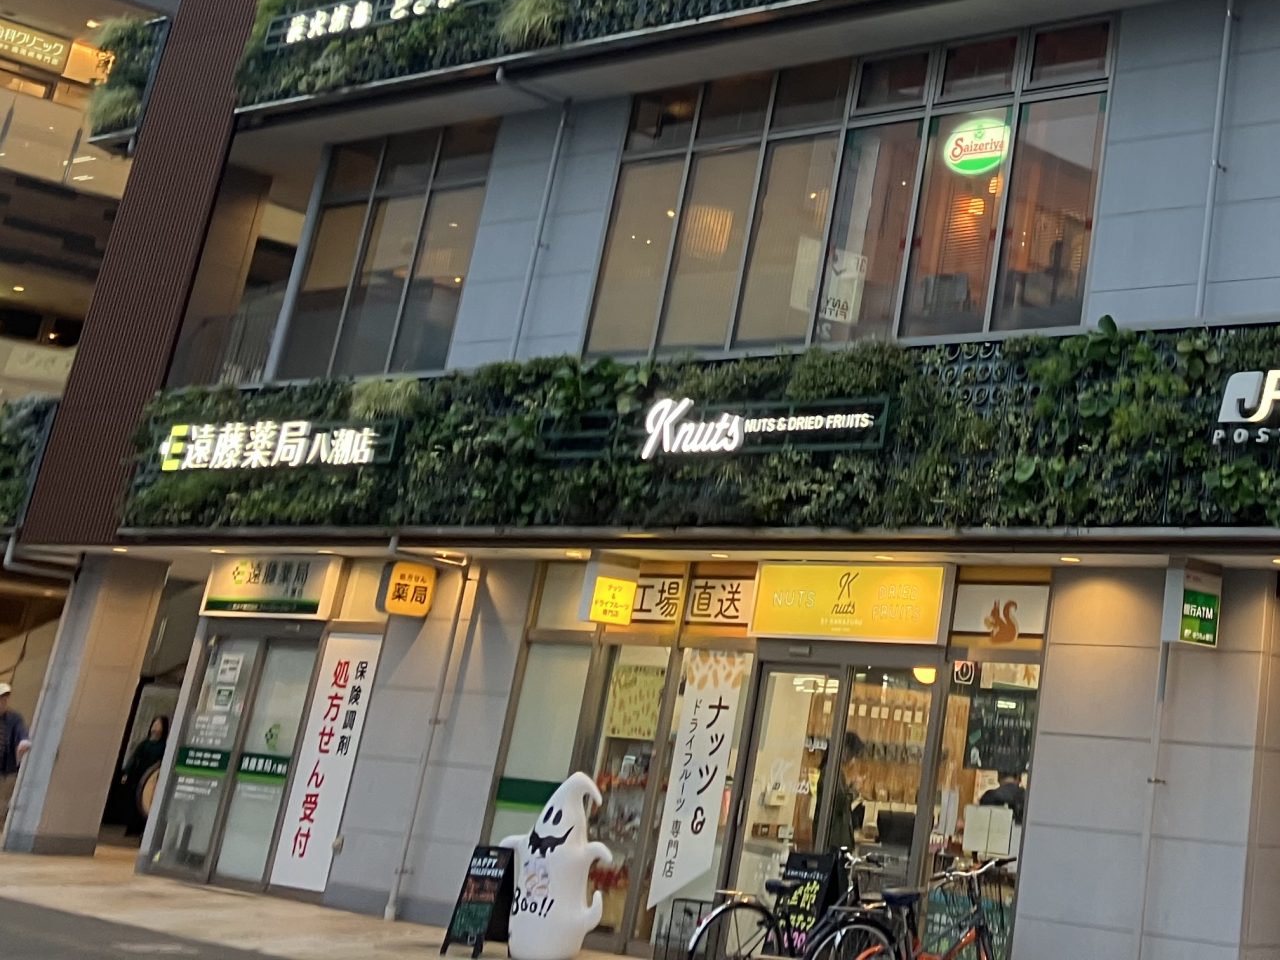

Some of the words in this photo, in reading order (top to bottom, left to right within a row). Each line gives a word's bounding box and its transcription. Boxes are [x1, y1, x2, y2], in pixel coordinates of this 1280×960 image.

[950, 136, 1004, 161] Saizeriya
[641, 397, 745, 460] Knuts
[744, 416, 776, 434] NUTS
[776, 416, 787, 432] &
[787, 415, 824, 431] DRIED
[825, 412, 871, 430] FRUITS
[181, 420, 312, 471] 遠藤薬局
[305, 427, 377, 466] 八潮店
[391, 583, 428, 605] 薬局
[773, 590, 816, 608] NUTS
[838, 571, 860, 601] K
[879, 585, 920, 601] DRIED
[831, 601, 856, 615] nuts
[871, 603, 922, 624] FRUITS
[335, 660, 369, 757] 保険調剤
[290, 659, 351, 860] 処方せん受付
[675, 698, 703, 813] ドライフルーツ
[471, 856, 498, 868] HAPPY
[661, 819, 682, 879] 専門店
